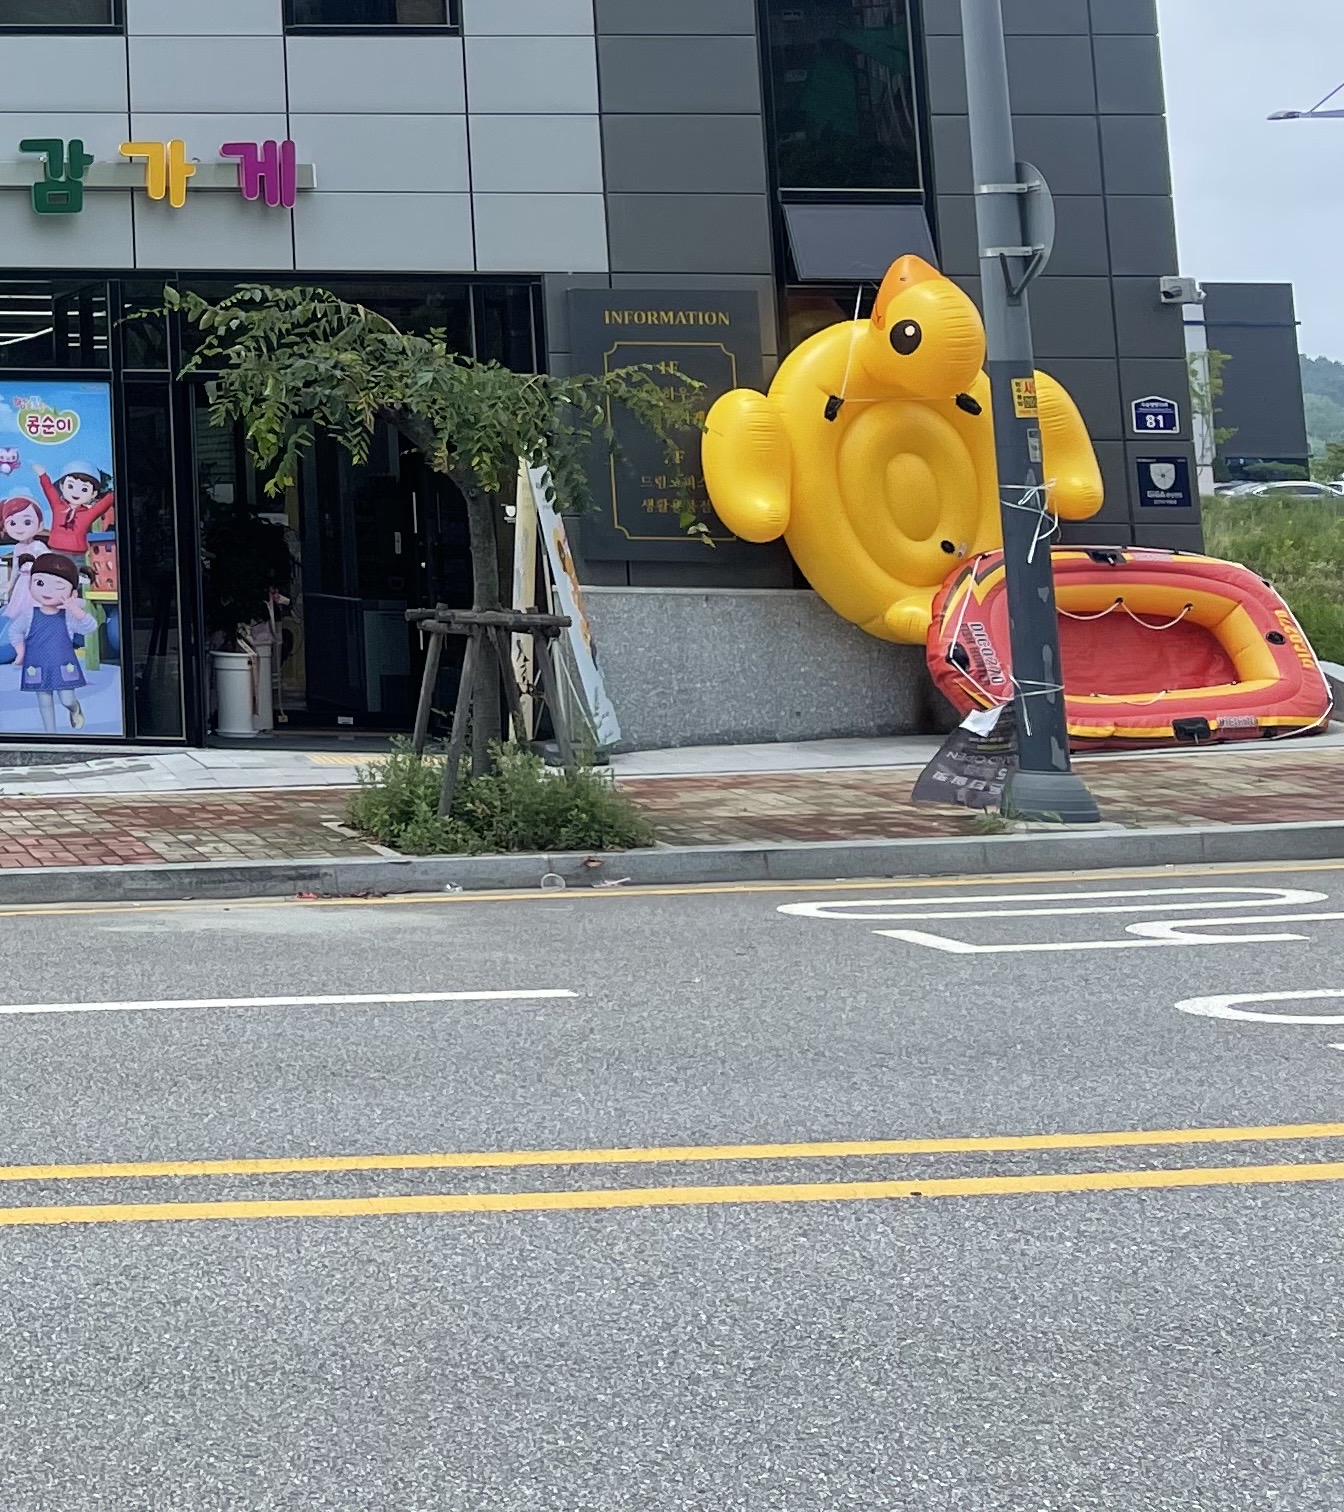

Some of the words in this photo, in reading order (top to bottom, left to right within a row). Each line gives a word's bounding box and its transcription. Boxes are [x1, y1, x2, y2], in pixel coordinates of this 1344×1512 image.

[604, 310, 730, 326] INFORMATION
[26, 415, 72, 435] 콩순이
[1145, 414, 1164, 428] 81
